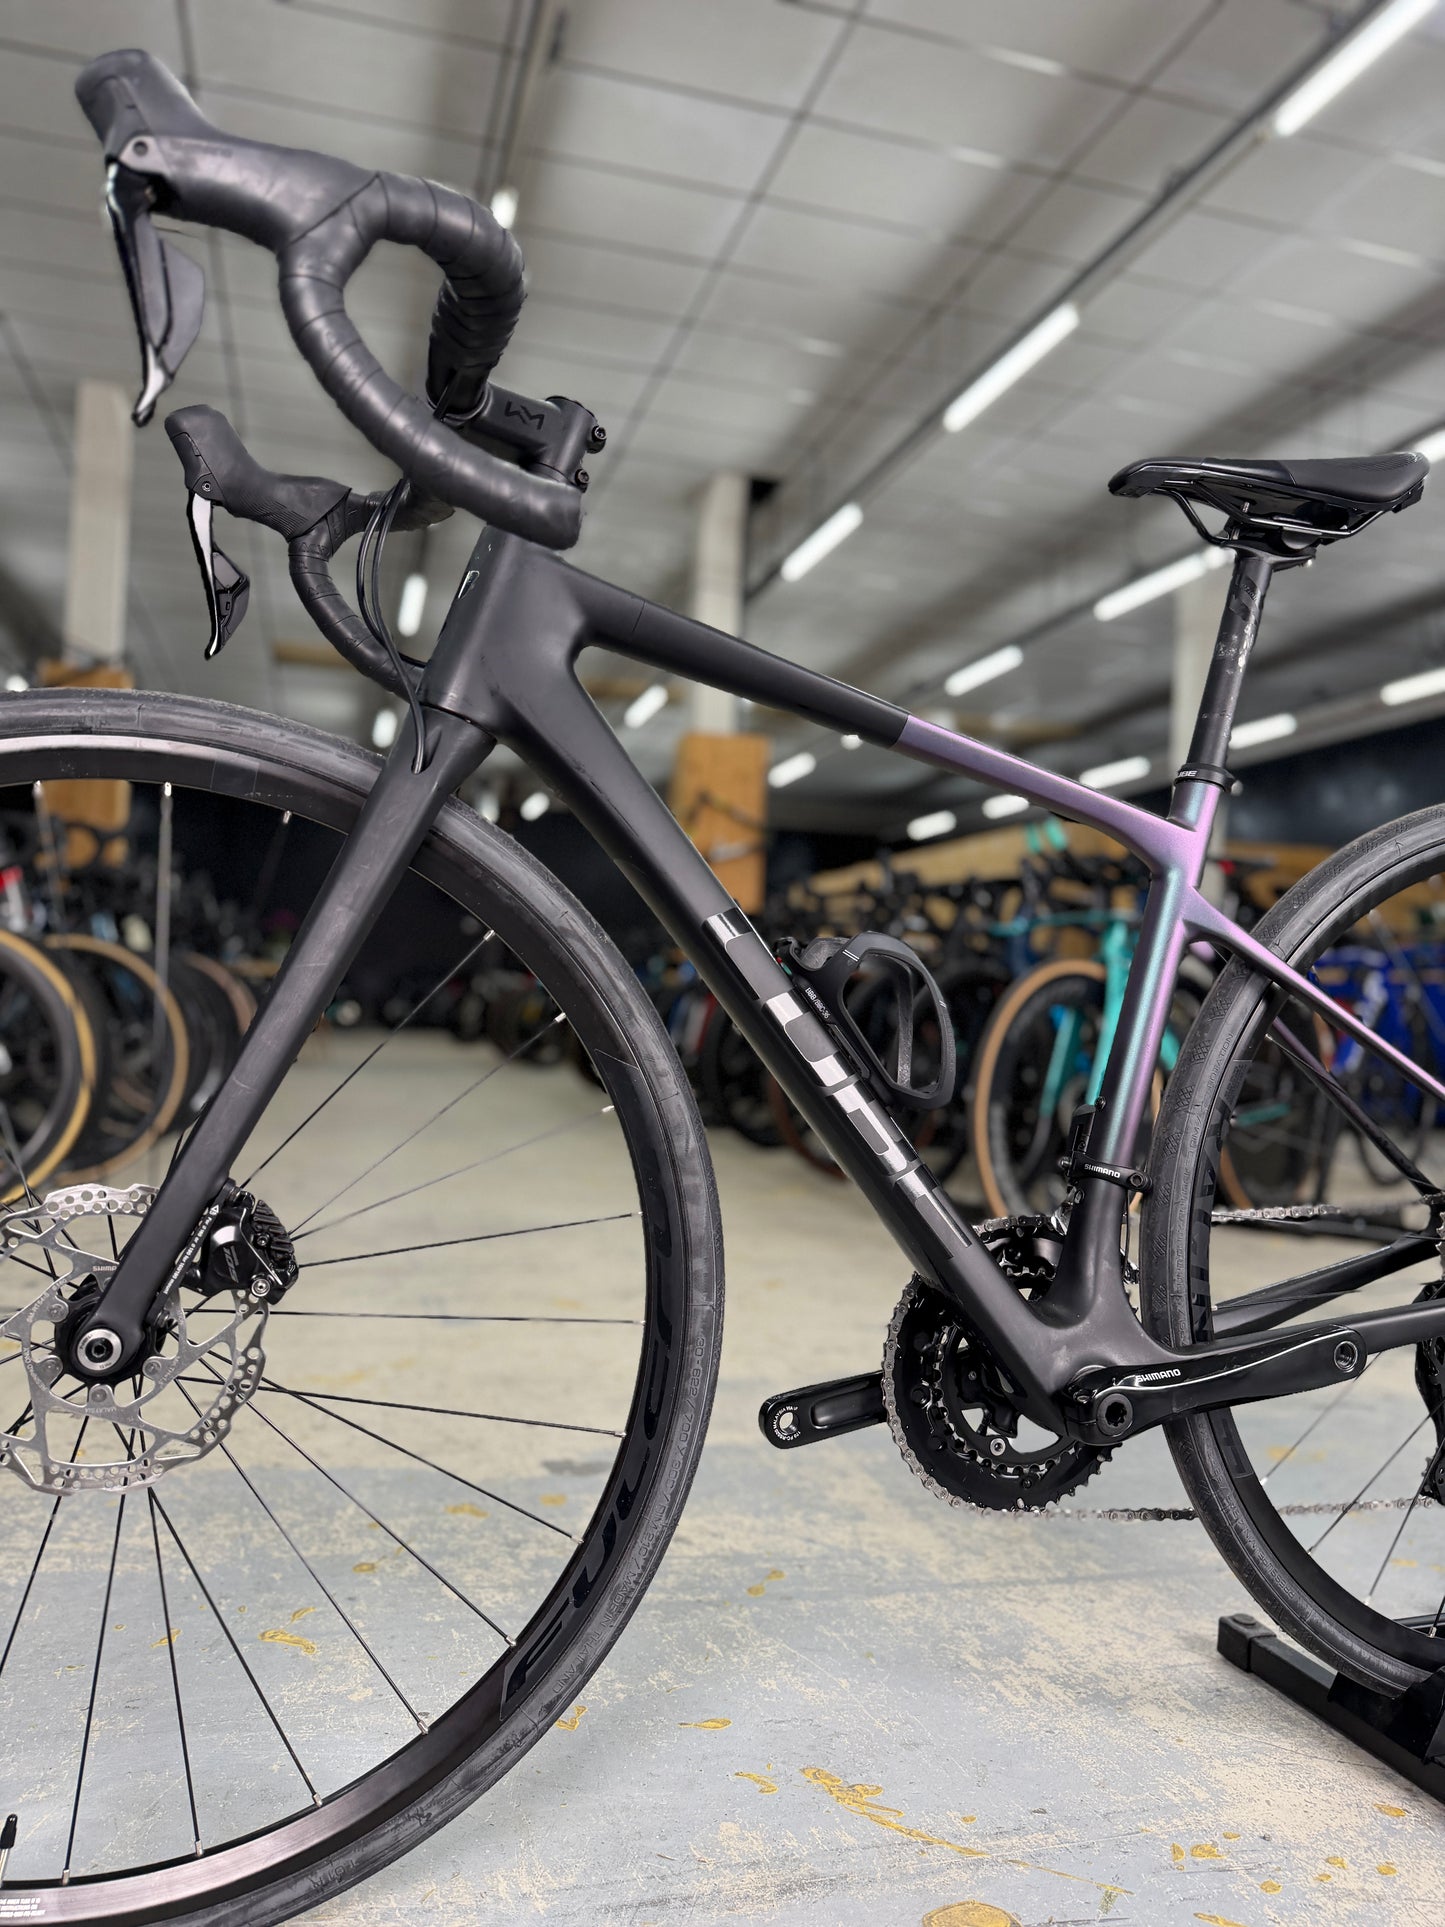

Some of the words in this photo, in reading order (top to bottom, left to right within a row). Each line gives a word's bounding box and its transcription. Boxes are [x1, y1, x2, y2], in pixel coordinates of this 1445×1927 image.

[702, 907, 973, 1260] CUBE
[1084, 1164, 1120, 1178] SHIMANO
[1136, 1368, 1181, 1384] SHIMANO
[505, 1148, 673, 1703] FULCRU
[679, 1414, 694, 1444] 700
[553, 1630, 600, 1694] THAILAND
